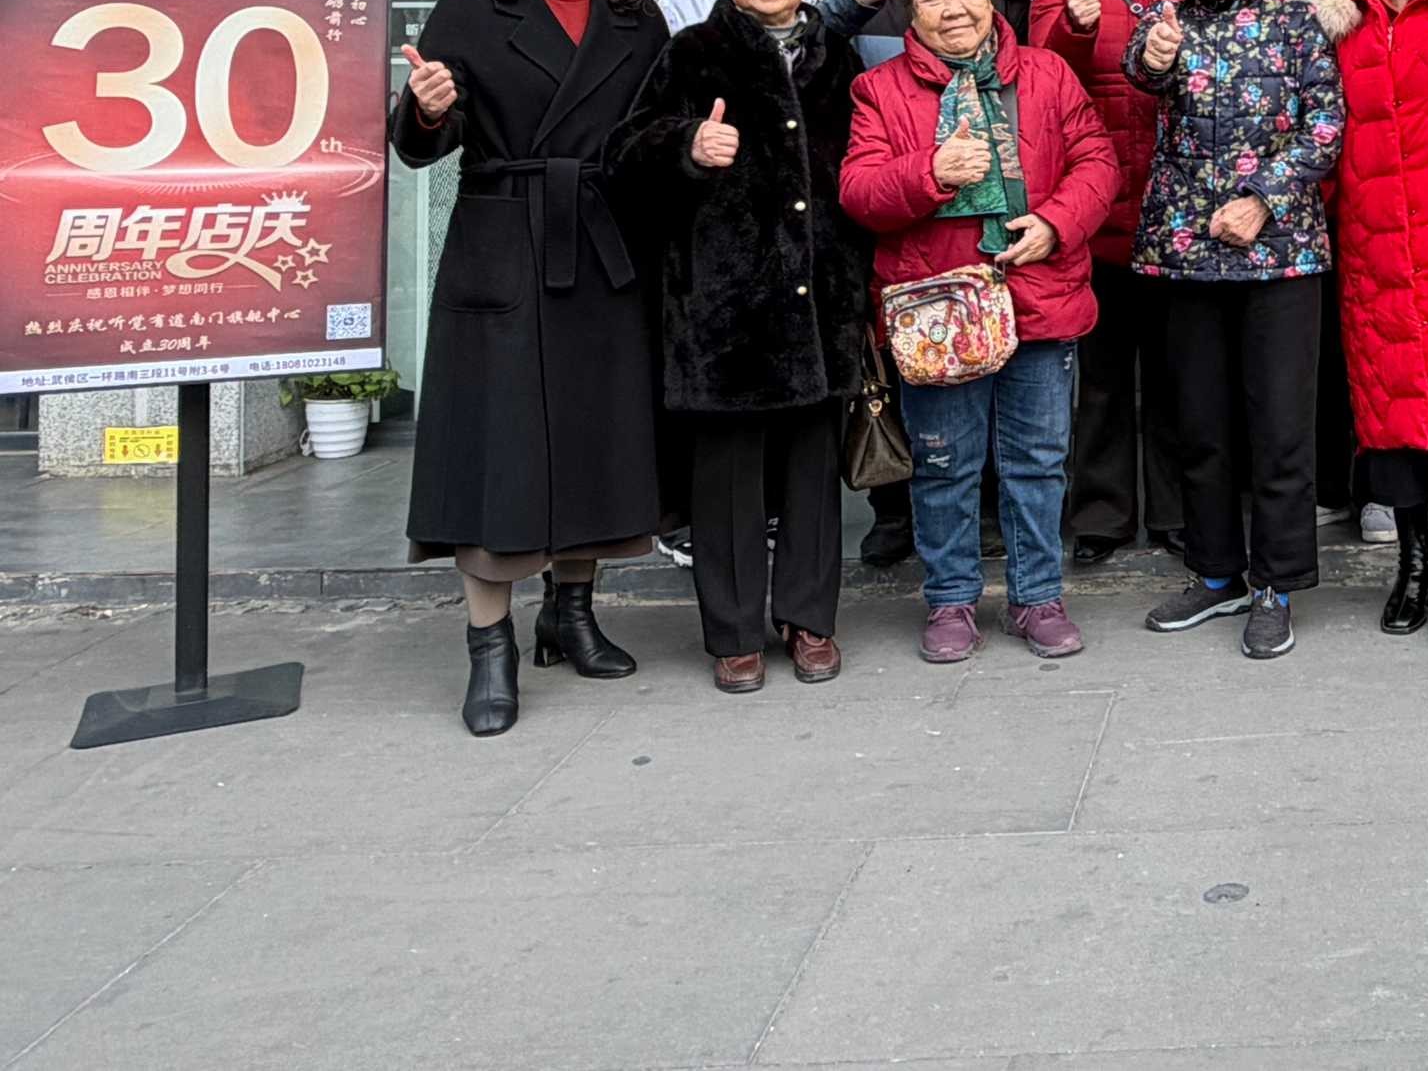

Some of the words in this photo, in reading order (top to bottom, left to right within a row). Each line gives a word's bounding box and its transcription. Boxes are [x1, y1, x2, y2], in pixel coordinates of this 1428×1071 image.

[42, 2, 329, 172] 30
[319, 136, 344, 155] th
[44, 259, 164, 275] ANNIVERSARY
[45, 195, 312, 291] 周年店庆
[44, 269, 162, 285] CELEBRATION
